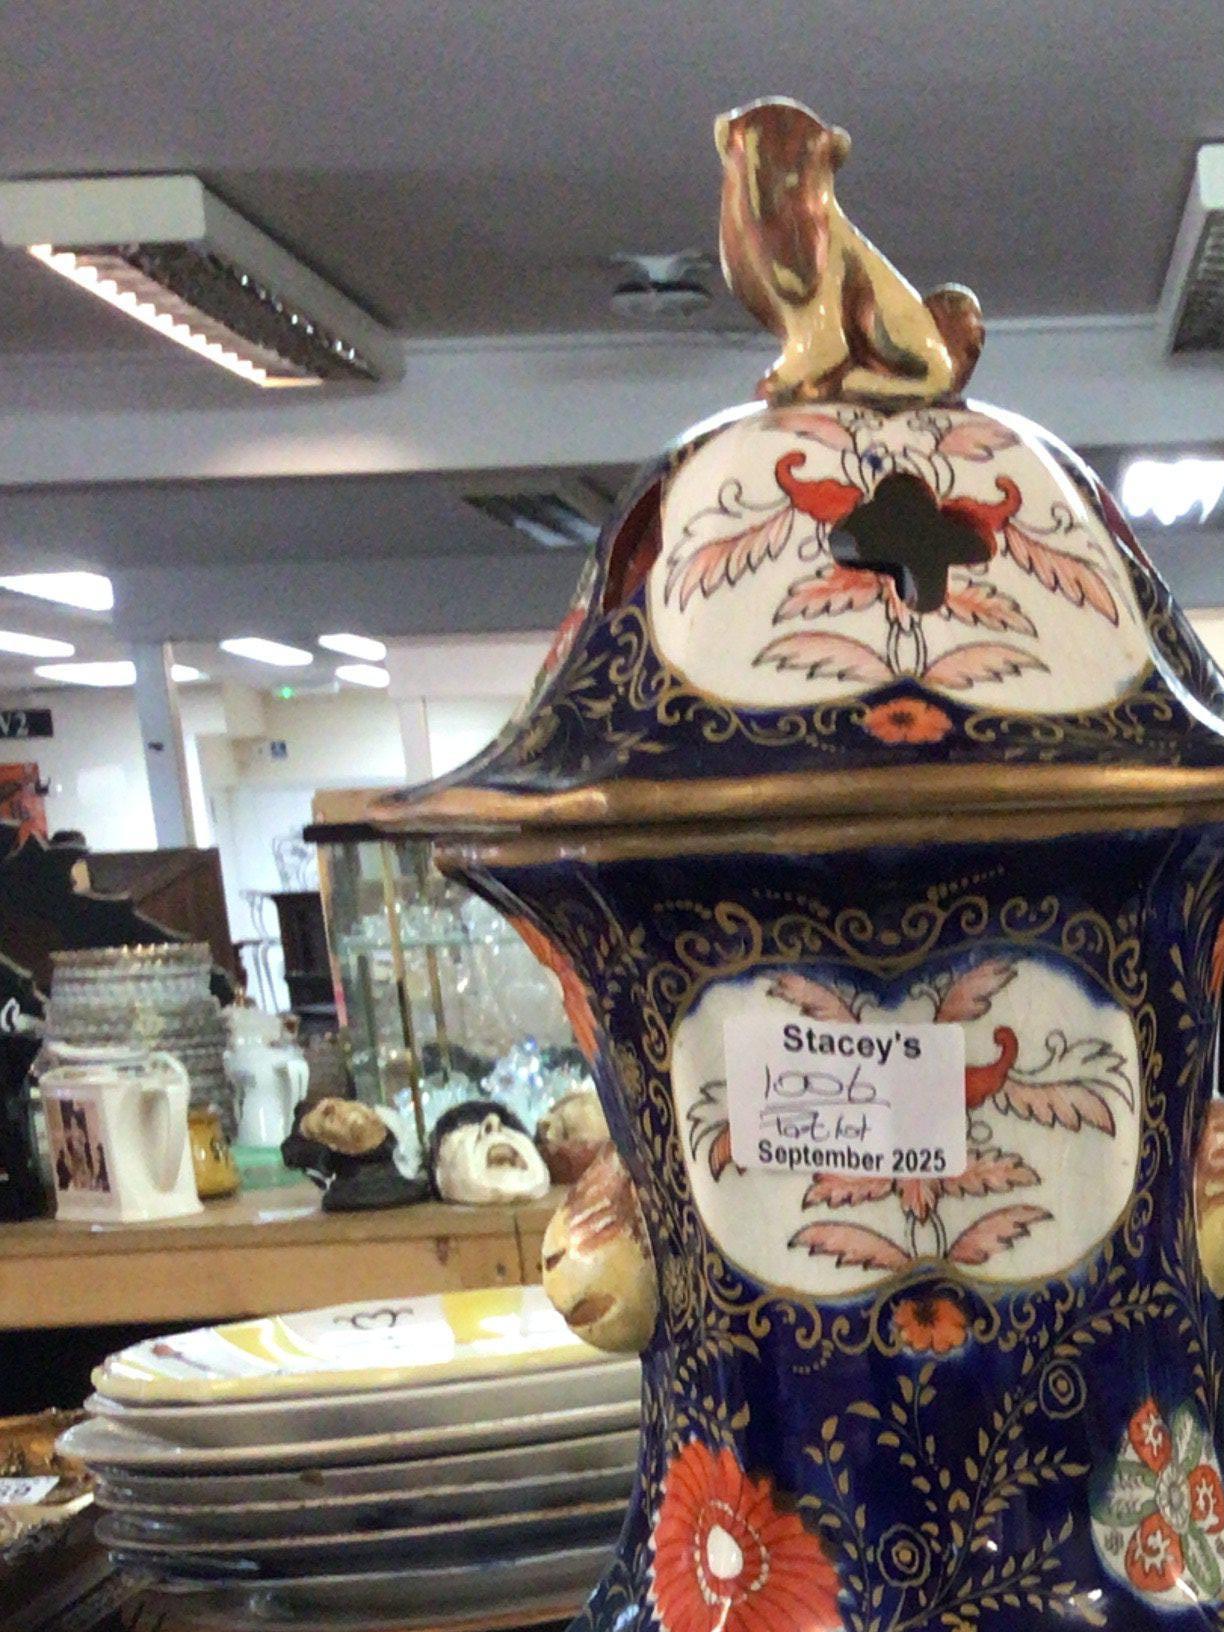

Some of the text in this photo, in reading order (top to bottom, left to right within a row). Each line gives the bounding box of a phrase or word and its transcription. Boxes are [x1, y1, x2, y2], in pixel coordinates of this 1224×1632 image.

[783, 1024, 921, 1064] Stacey's
[764, 1065, 877, 1102] 1006
[758, 1139, 946, 1172] September 2025
